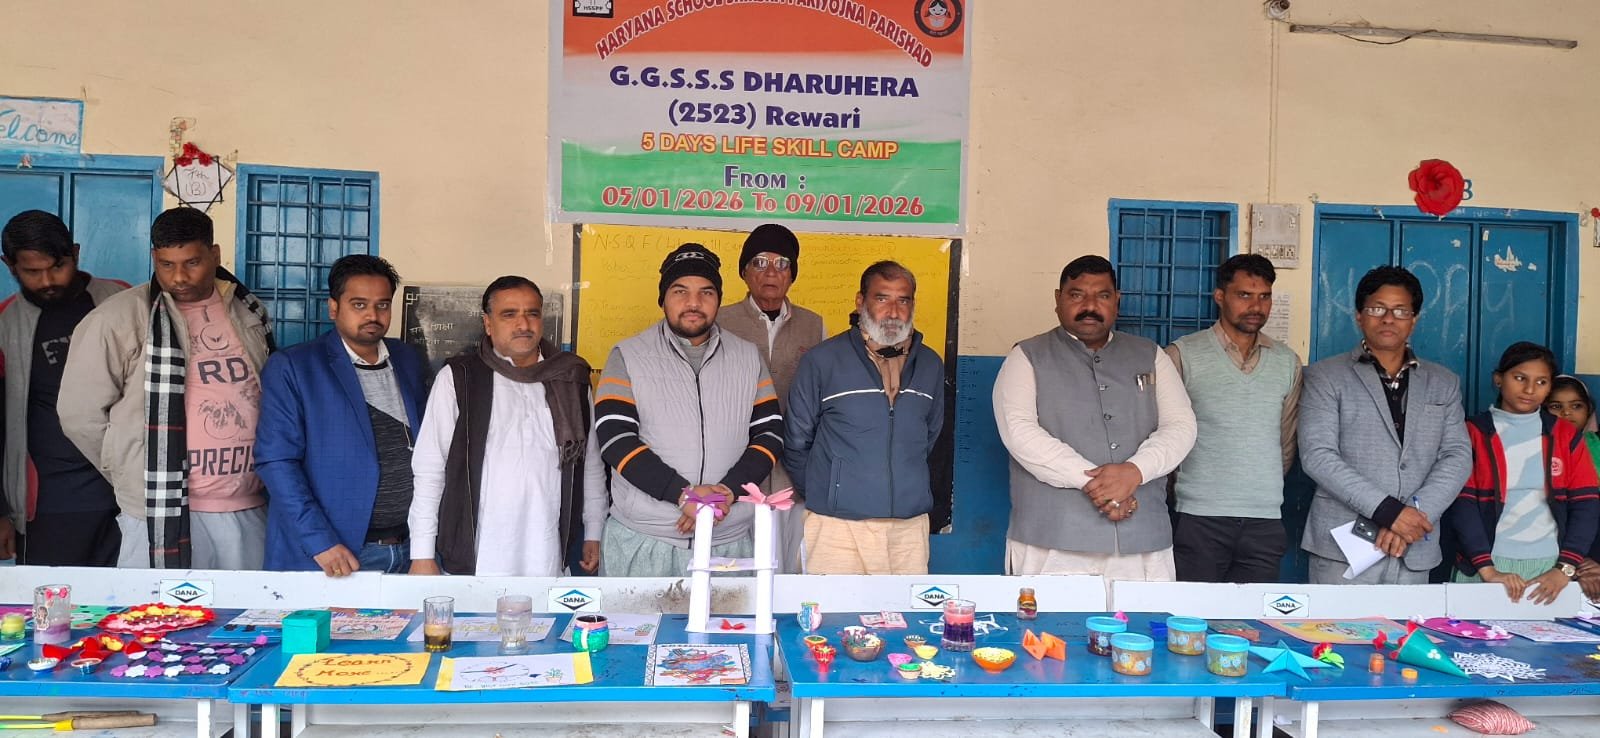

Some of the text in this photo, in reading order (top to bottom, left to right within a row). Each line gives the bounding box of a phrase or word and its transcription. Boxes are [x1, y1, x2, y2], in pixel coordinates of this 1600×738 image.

[596, 7, 666, 60] HARYANA
[868, 11, 933, 68] PARISHAD
[609, 65, 920, 98] G.G.S.S.S DHARUHERA
[668, 98, 861, 130] (2523) Rewari
[641, 131, 899, 160] 5 DAYS LIFE SKILL CAMP
[601, 186, 745, 212] 05/01/2026
[785, 191, 925, 217] 09/01/2026
[198, 357, 249, 384] RD
[187, 446, 254, 476] PRECI
[175, 589, 199, 597] DANA
